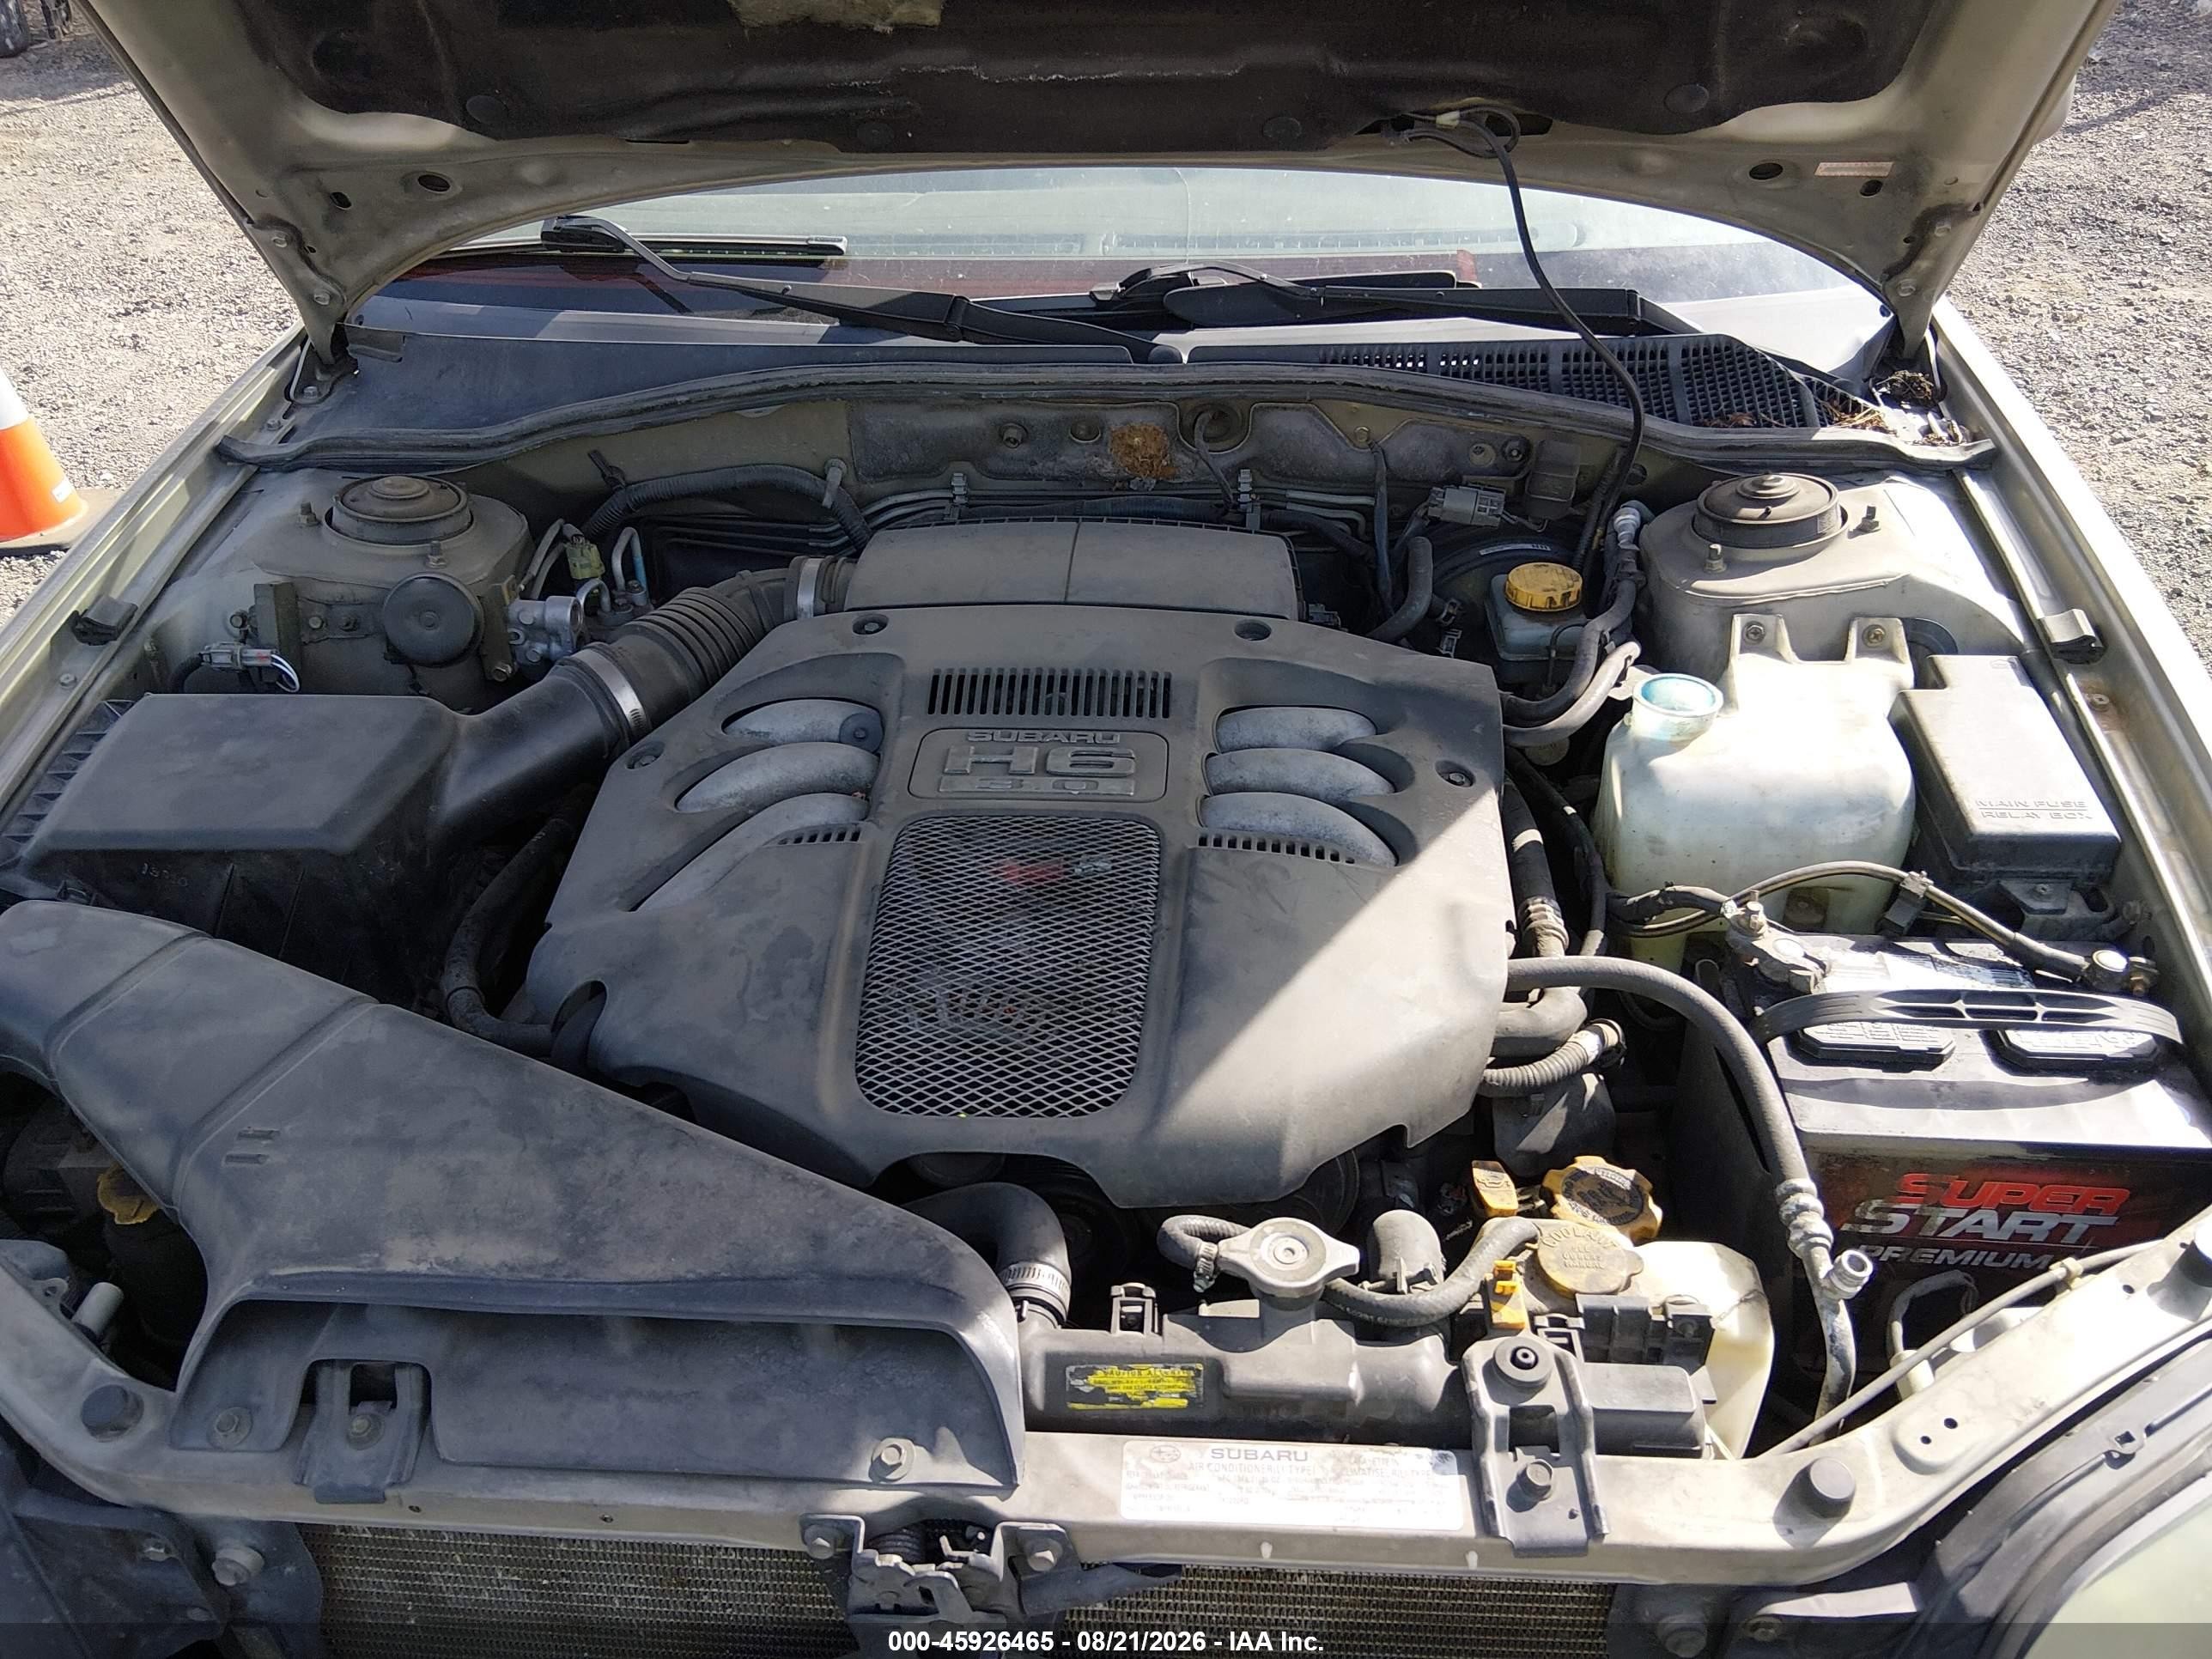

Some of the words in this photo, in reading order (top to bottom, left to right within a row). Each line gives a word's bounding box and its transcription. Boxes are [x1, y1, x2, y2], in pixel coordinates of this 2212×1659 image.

[967, 730, 1121, 744] SUBARU
[944, 745, 1136, 777] H6
[1975, 799, 2031, 808] MAIN
[1981, 811, 2041, 819] RELAY
[1895, 1173, 2130, 1216] SUPER
[1839, 1199, 2121, 1244] START
[1858, 1243, 2055, 1270] PREMIUM
[1211, 1448, 1309, 1462] SUBARU
